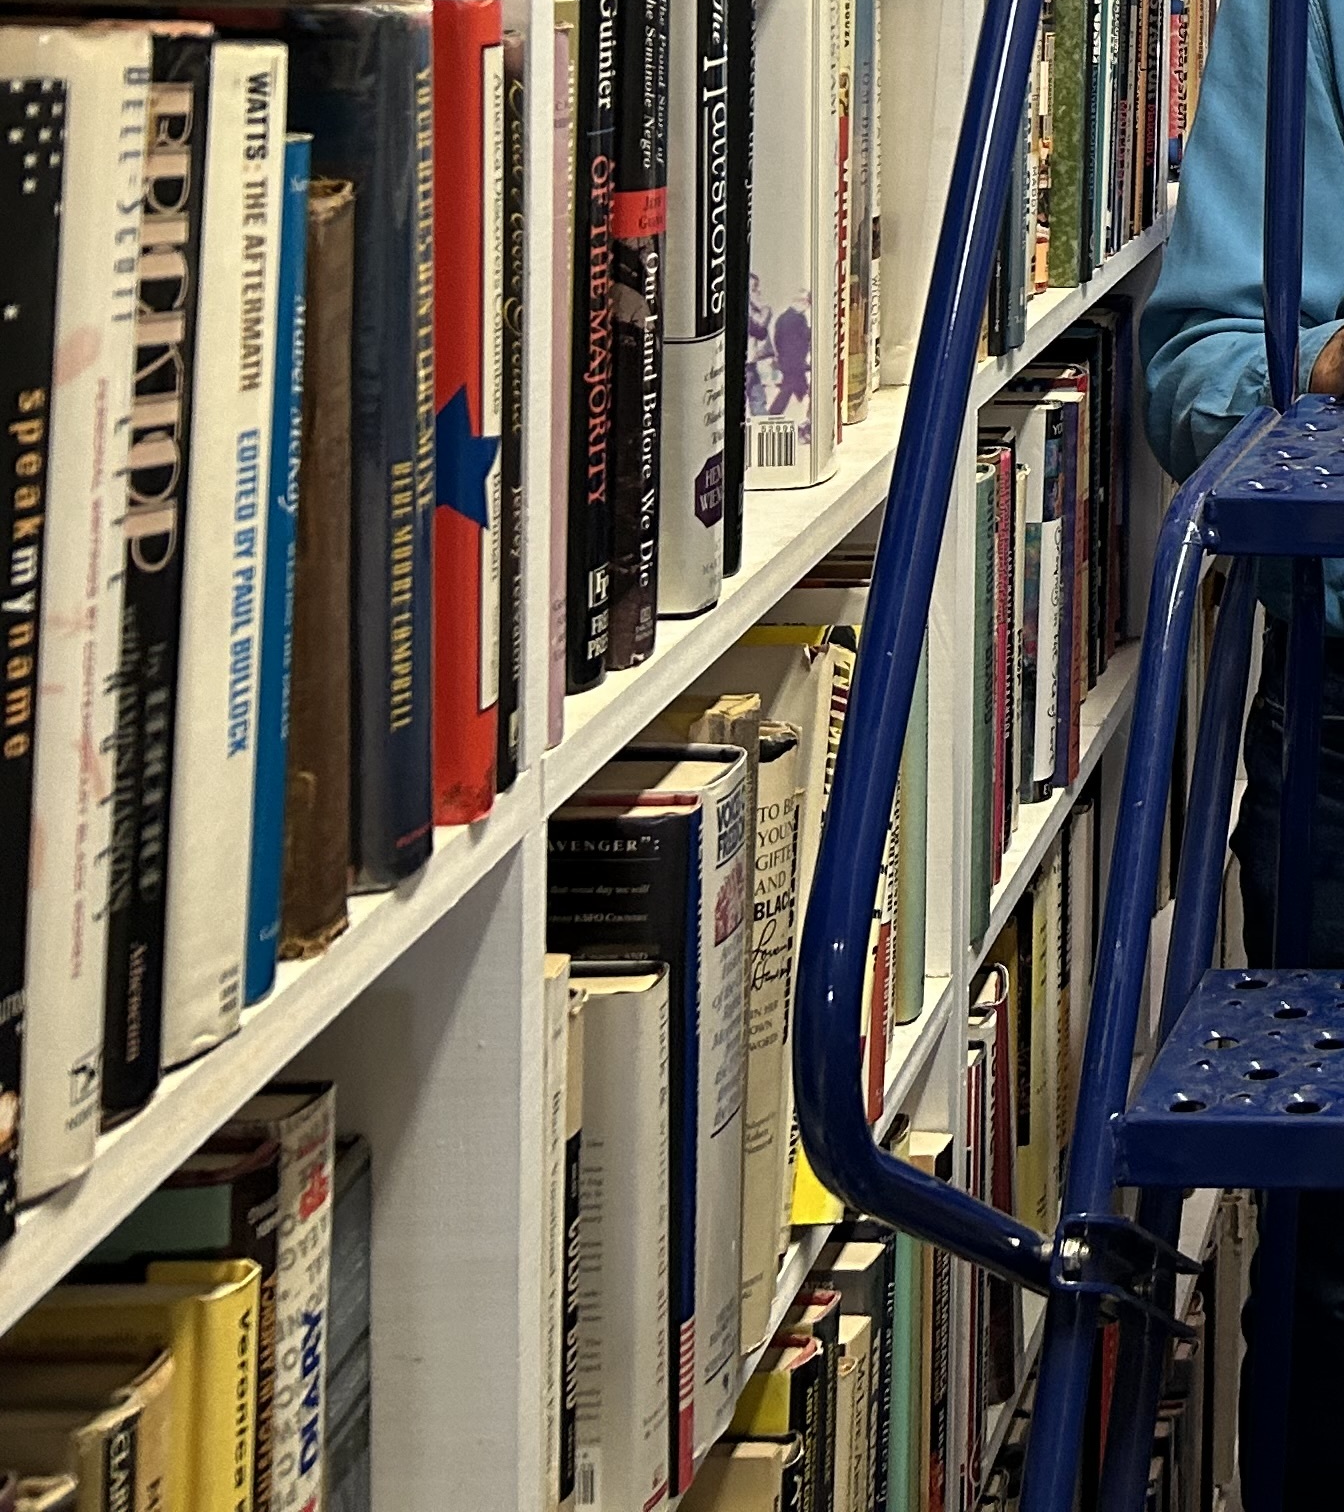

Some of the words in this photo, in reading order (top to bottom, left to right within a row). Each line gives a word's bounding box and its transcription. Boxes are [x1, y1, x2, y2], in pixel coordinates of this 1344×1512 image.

[243, 176, 269, 226] THE
[588, 154, 612, 202] OF
[587, 223, 611, 299] THE
[640, 250, 660, 302] Our
[122, 79, 195, 574] BRICKTOP
[239, 233, 268, 393] AFTERMATH
[639, 315, 660, 383] Land
[585, 306, 612, 509] MAJORITY
[637, 391, 659, 480] Before
[233, 430, 261, 522] EDITED
[636, 487, 657, 532] We
[2, 389, 48, 760] speakmyname
[233, 527, 259, 560] BY
[636, 539, 655, 587] Die
[229, 566, 256, 636] PAUL
[226, 636, 254, 760] BULLOCK
[390, 610, 413, 735] CAMPBELL
